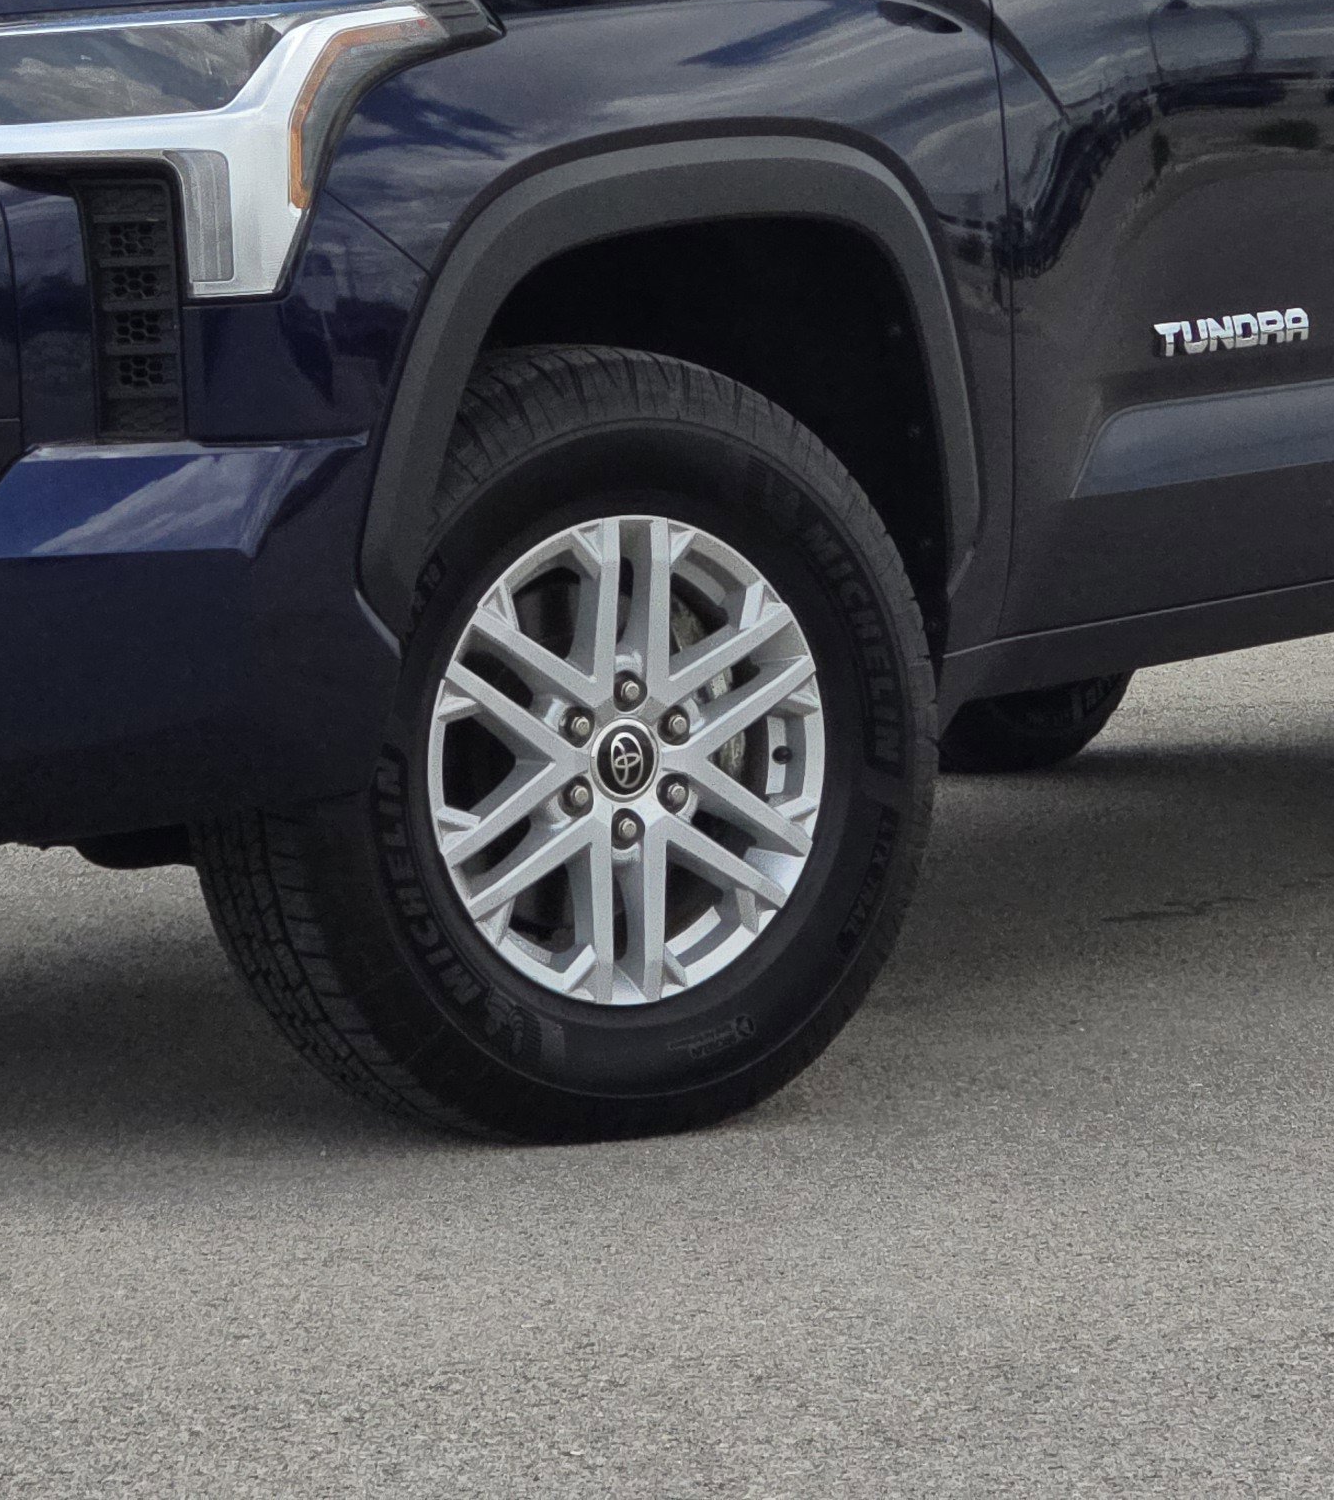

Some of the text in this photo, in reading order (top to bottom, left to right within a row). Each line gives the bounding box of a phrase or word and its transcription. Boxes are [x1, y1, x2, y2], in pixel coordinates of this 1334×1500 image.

[1153, 307, 1309, 357] TUNDRA
[801, 520, 900, 766] MICHELIN
[376, 760, 482, 1006] MICHELIN
